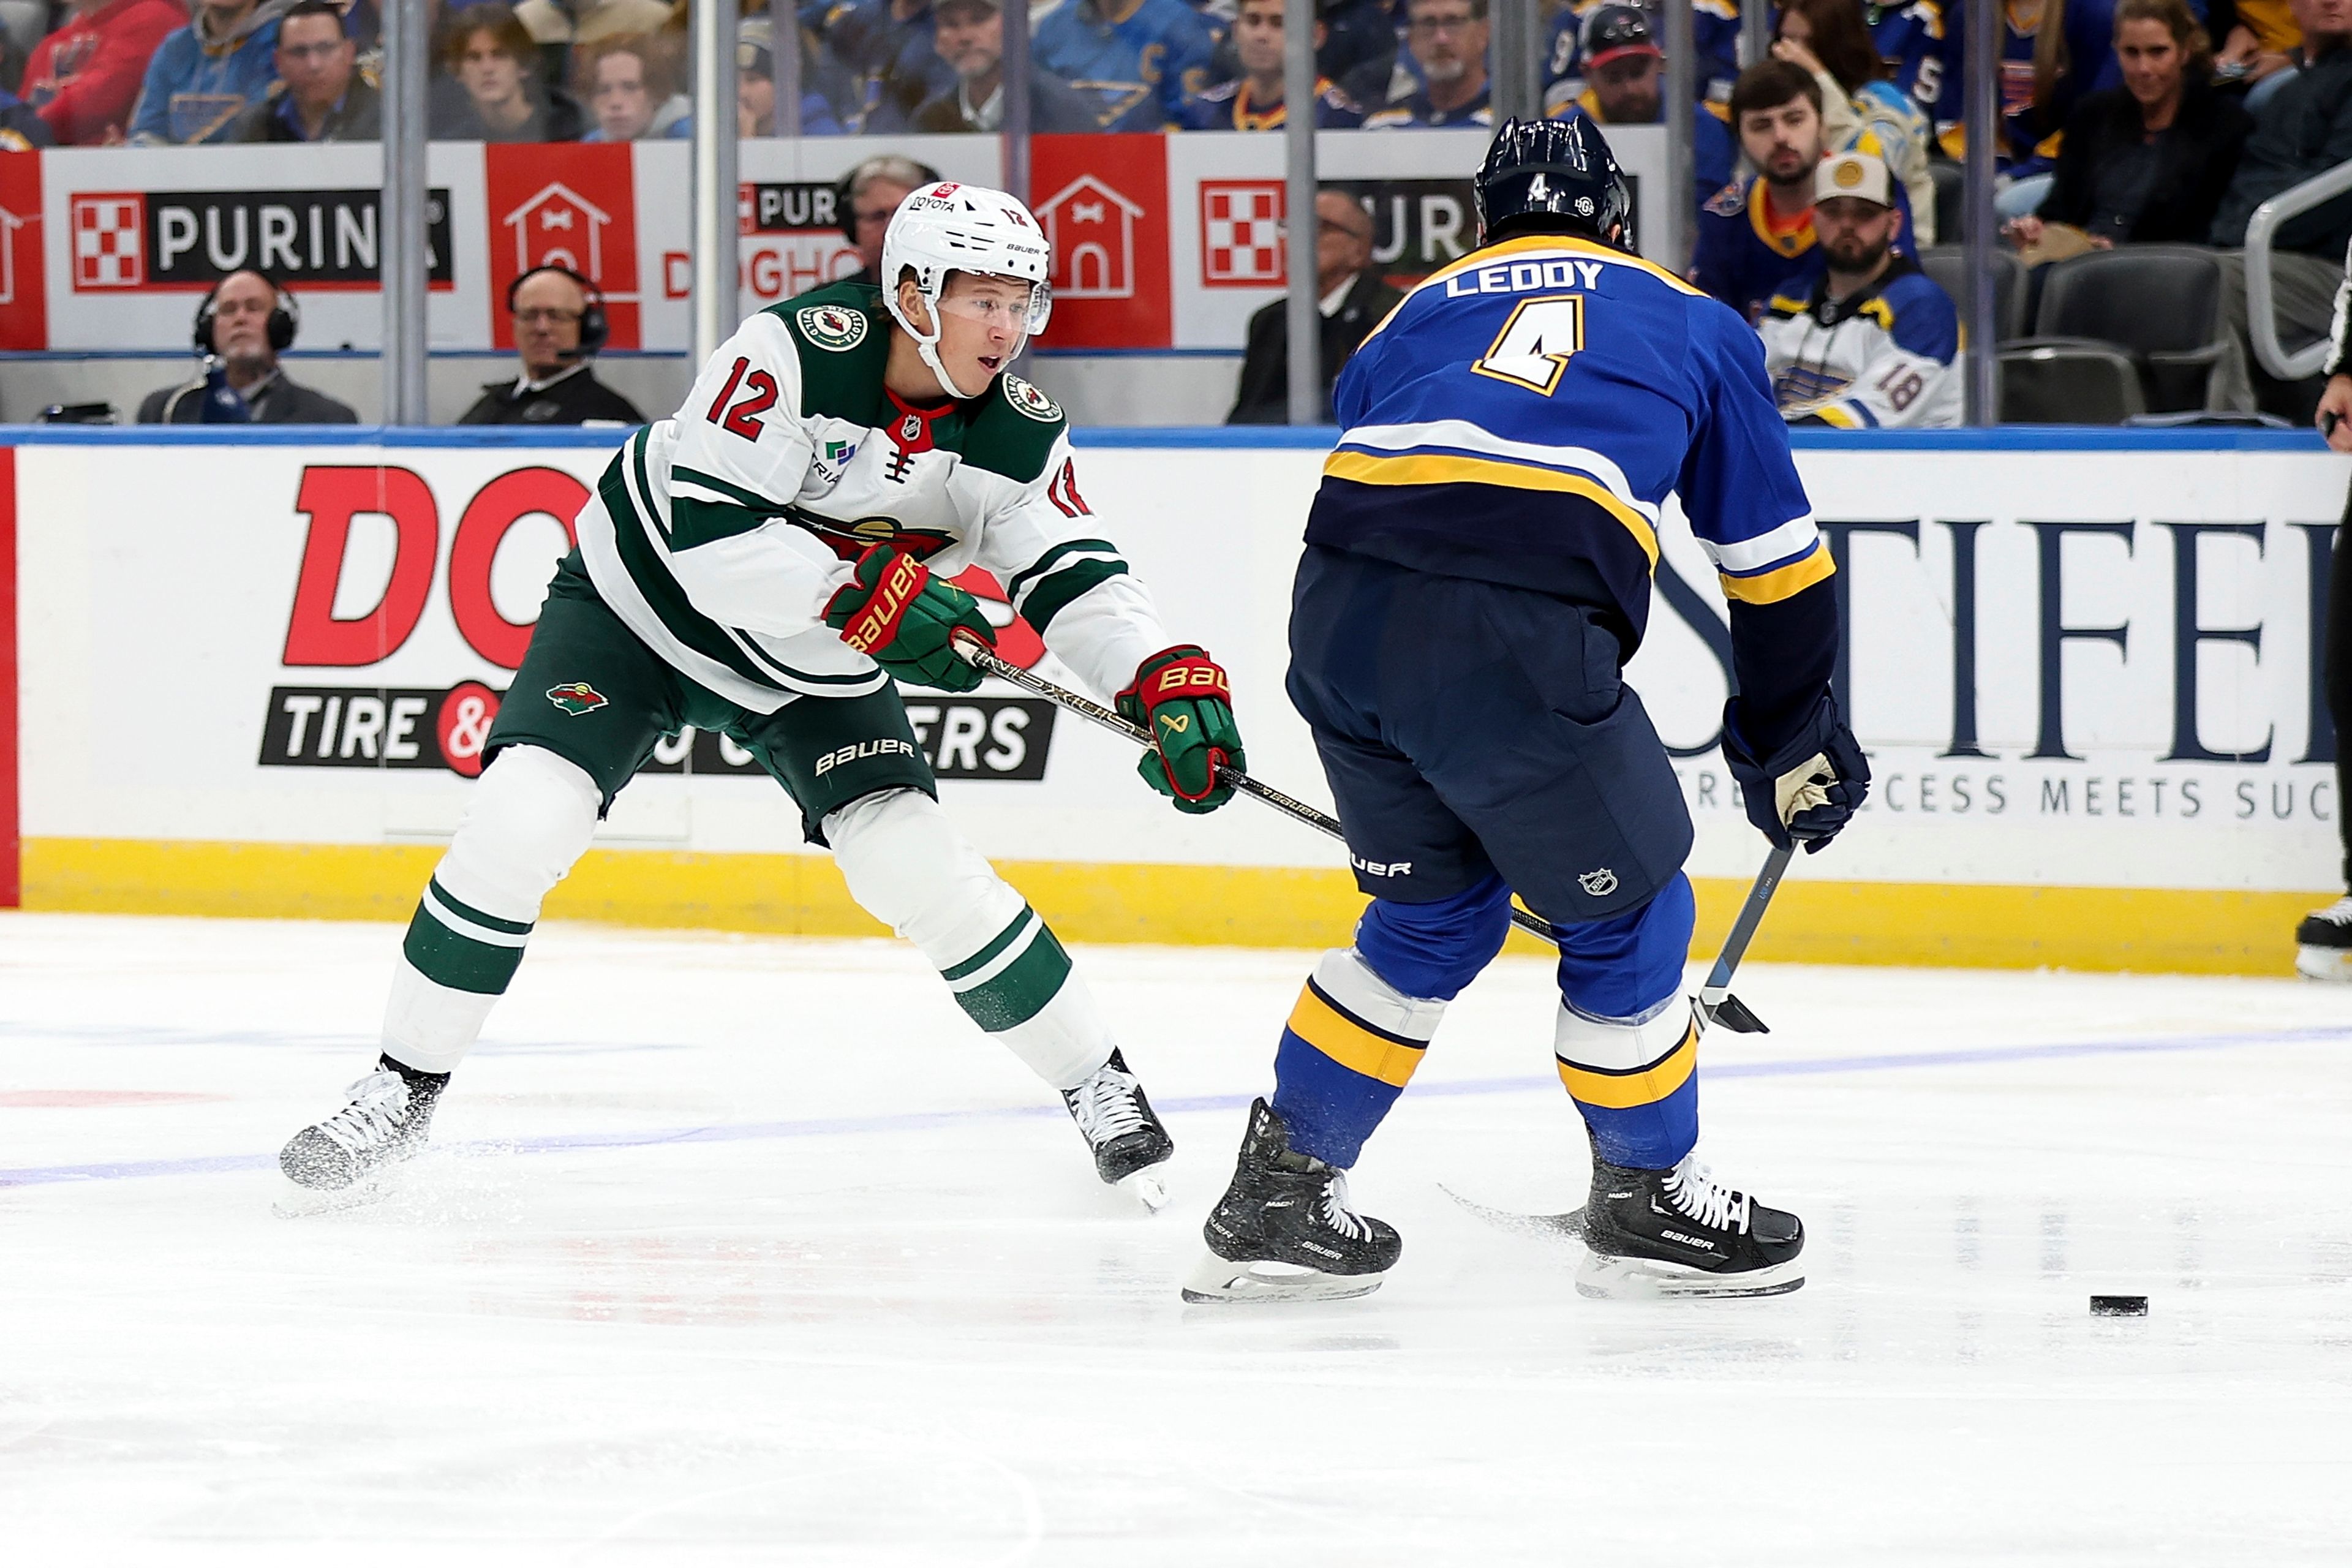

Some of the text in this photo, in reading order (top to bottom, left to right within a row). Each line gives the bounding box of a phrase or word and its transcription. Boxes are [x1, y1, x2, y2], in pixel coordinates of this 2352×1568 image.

[157, 204, 438, 271] PURIN
[1446, 261, 1604, 298] LEDDY
[1469, 293, 1585, 398] 4
[706, 356, 779, 443] 12
[283, 695, 428, 759] TIRE
[448, 696, 494, 758] &
[815, 739, 915, 777] BAUER
[2041, 777, 2202, 818] MEETS
[1301, 1240, 1343, 1261] BAUER
[1660, 1229, 1715, 1251] BAUER
